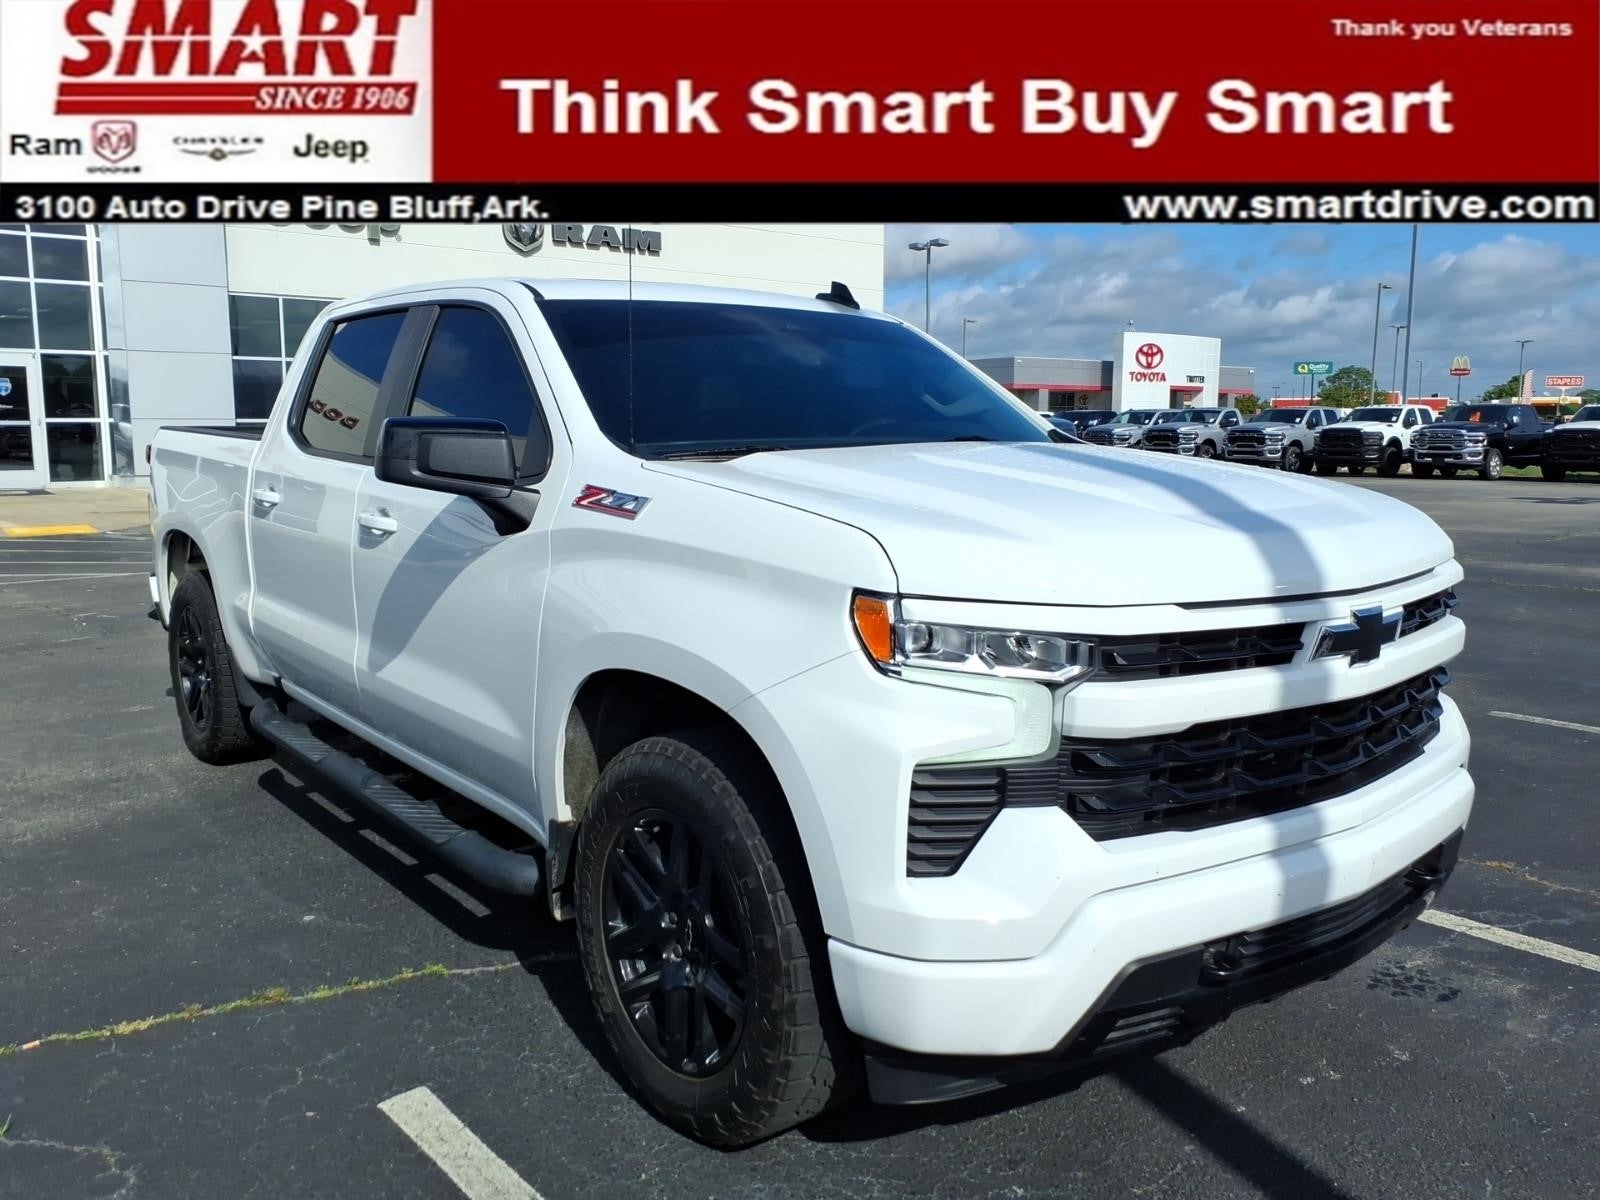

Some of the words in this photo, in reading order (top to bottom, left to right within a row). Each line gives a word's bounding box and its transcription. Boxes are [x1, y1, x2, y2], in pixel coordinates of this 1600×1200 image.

[551, 224, 662, 257] RAM
[1129, 371, 1166, 382] TOYOTA
[1547, 378, 1582, 386] STAPLES
[572, 483, 650, 520] Z71
